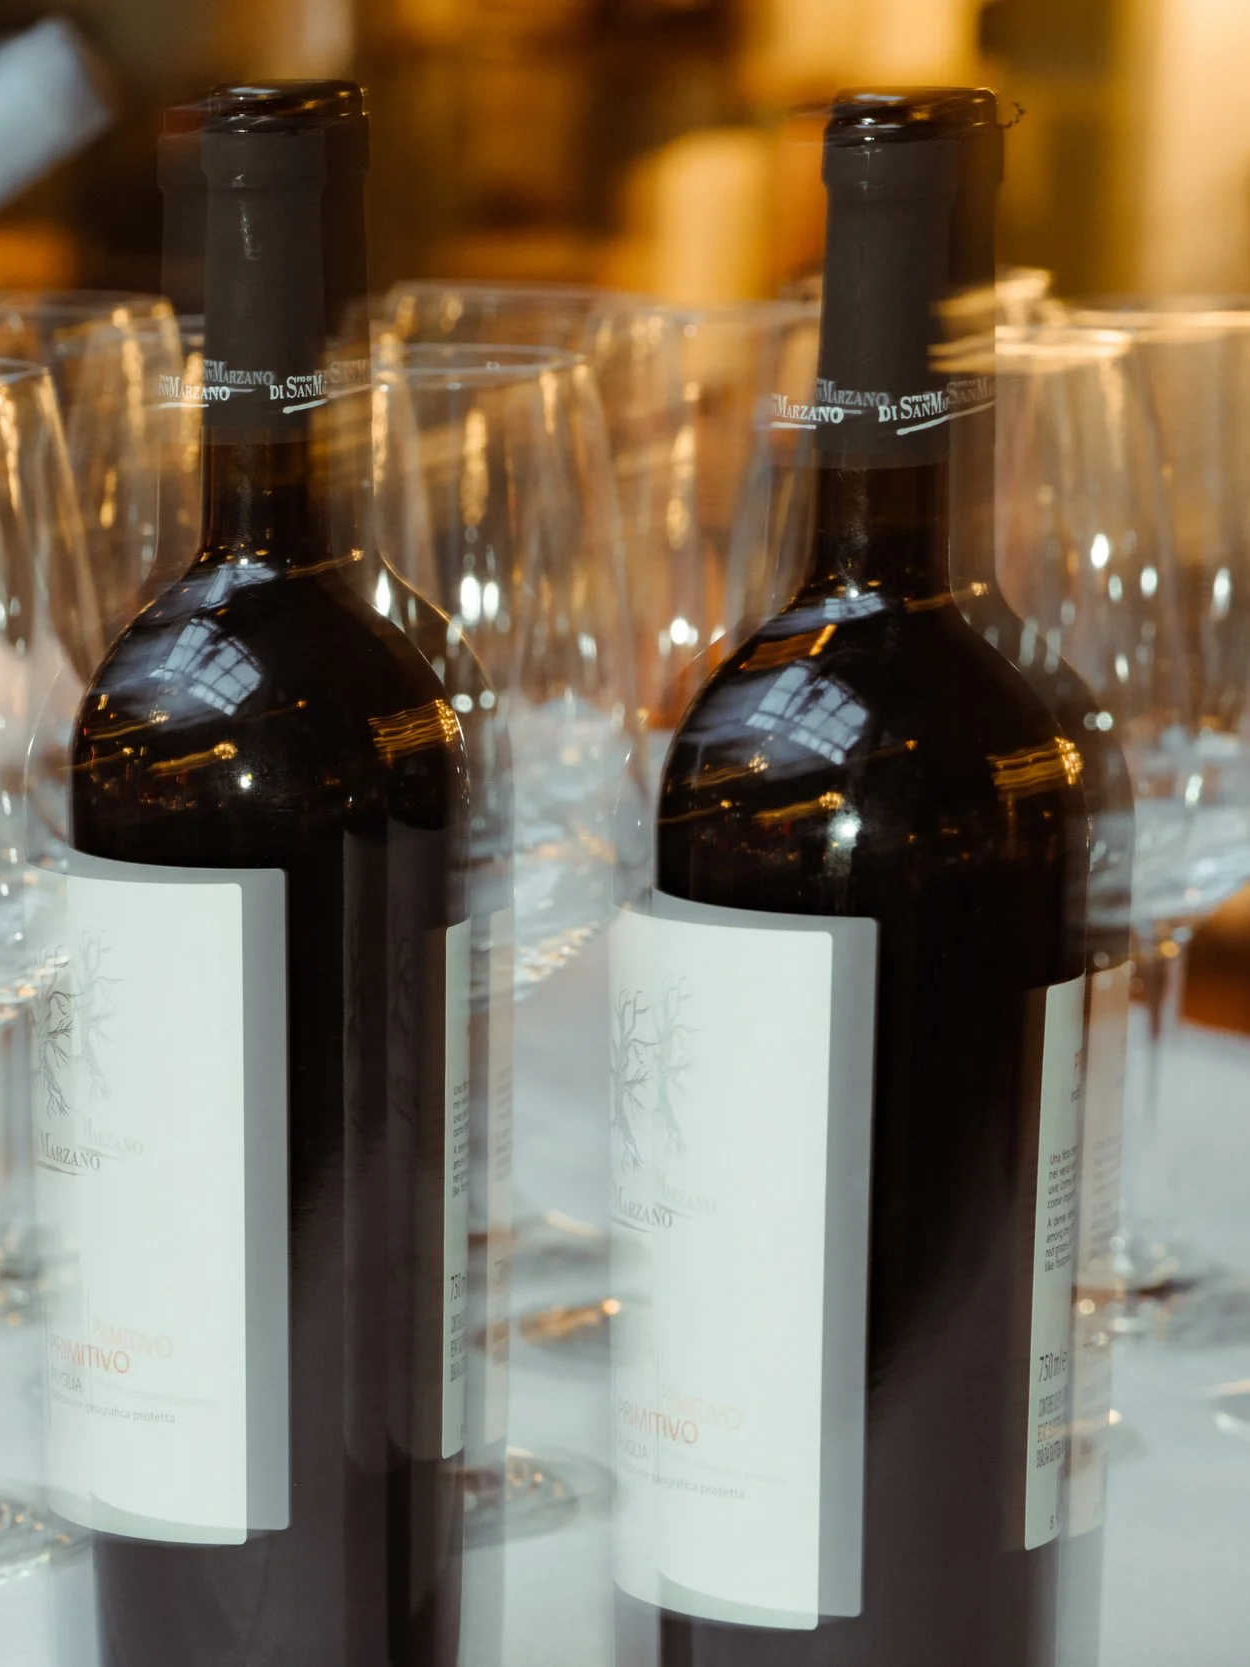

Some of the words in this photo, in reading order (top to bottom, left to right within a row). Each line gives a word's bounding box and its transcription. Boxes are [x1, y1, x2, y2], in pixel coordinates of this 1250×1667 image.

[50, 1332, 131, 1374] PRIMITIVO
[132, 1409, 176, 1425] protetta
[617, 1396, 699, 1445] PRIMITIVO
[699, 1483, 746, 1501] protetta
